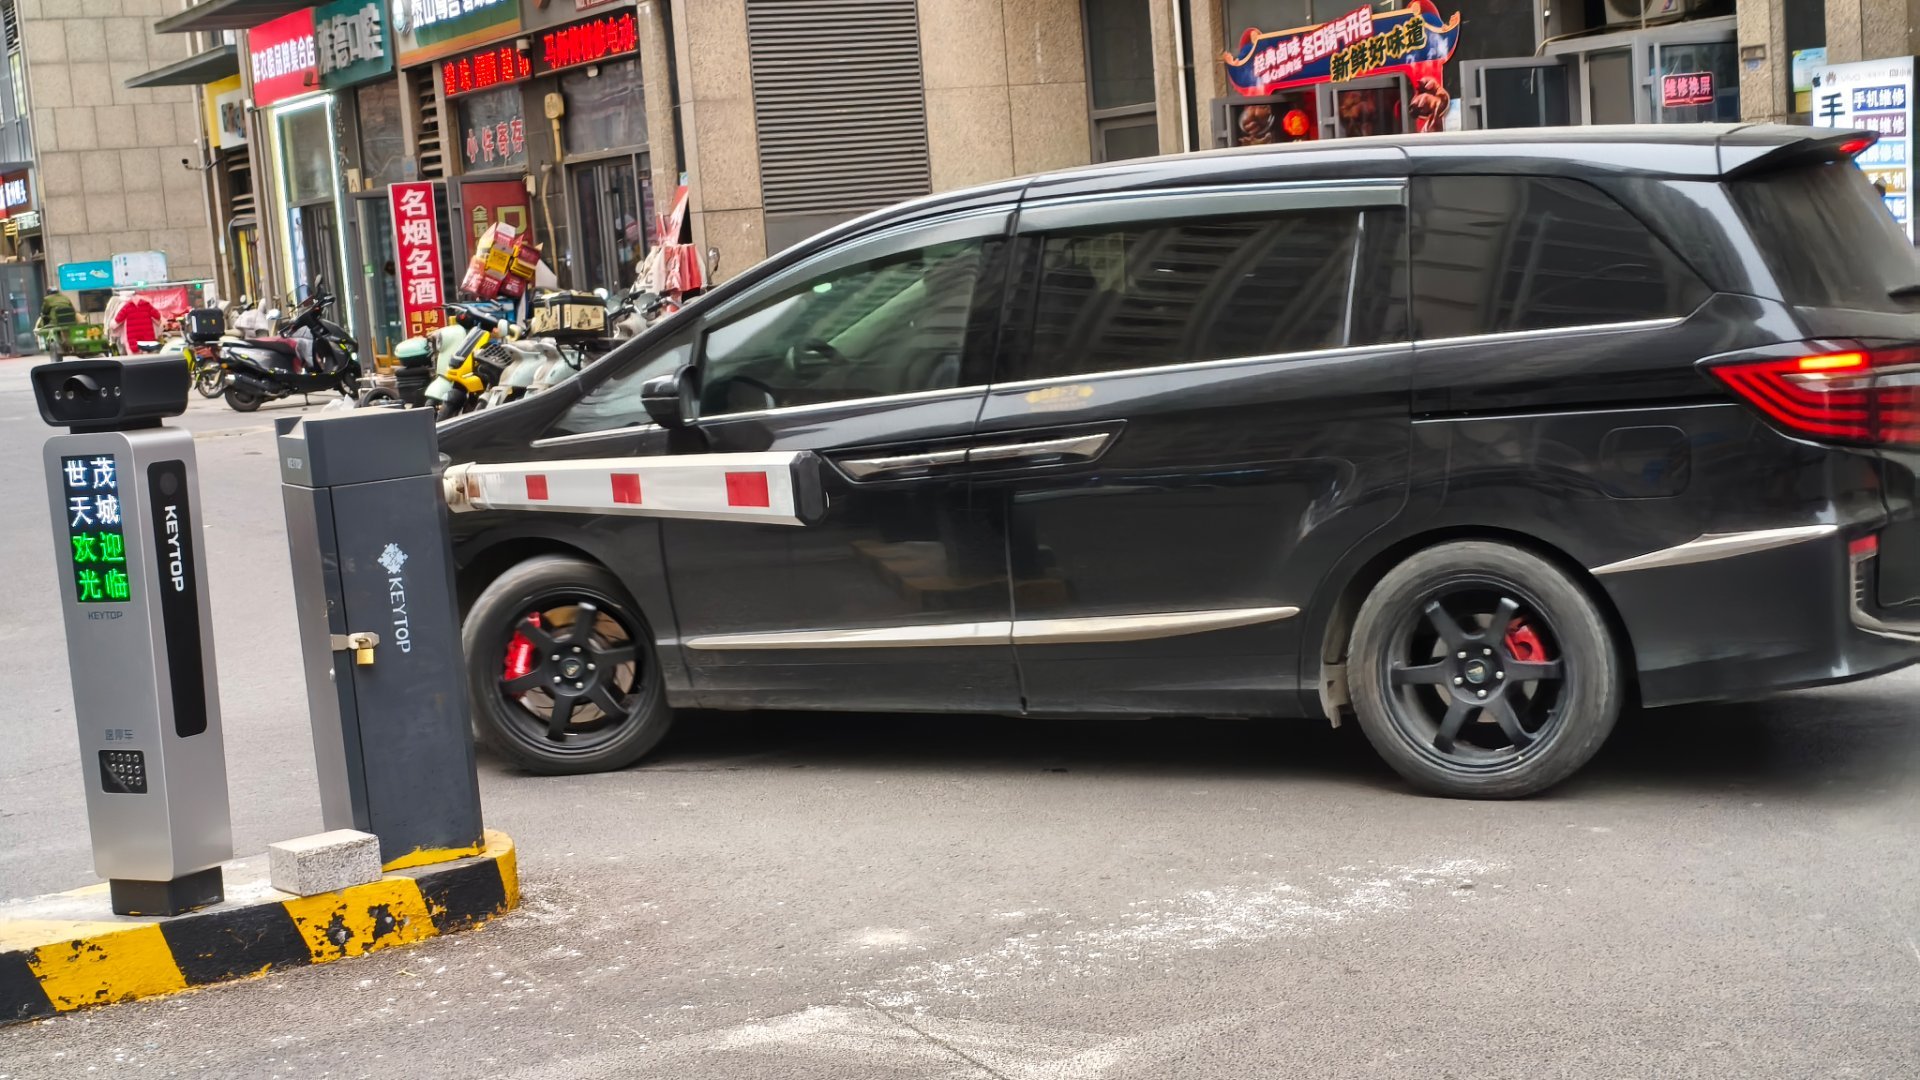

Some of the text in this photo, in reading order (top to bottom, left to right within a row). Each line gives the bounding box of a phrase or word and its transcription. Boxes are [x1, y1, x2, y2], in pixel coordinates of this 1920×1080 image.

[1331, 18, 1426, 82] 新鲜好味道
[1665, 76, 1711, 98] 维修换屏
[1854, 87, 1905, 109] 手机维修
[466, 115, 525, 163] 小件寄存
[399, 188, 438, 305] 名烟名酒
[64, 457, 117, 489] 世茂
[69, 494, 121, 528] 天城
[72, 532, 125, 563] 欢迎
[164, 505, 185, 592] KEYTOP
[79, 568, 129, 601] 光临
[88, 611, 123, 621] KEYTOP
[389, 577, 411, 653] KEYTOP
